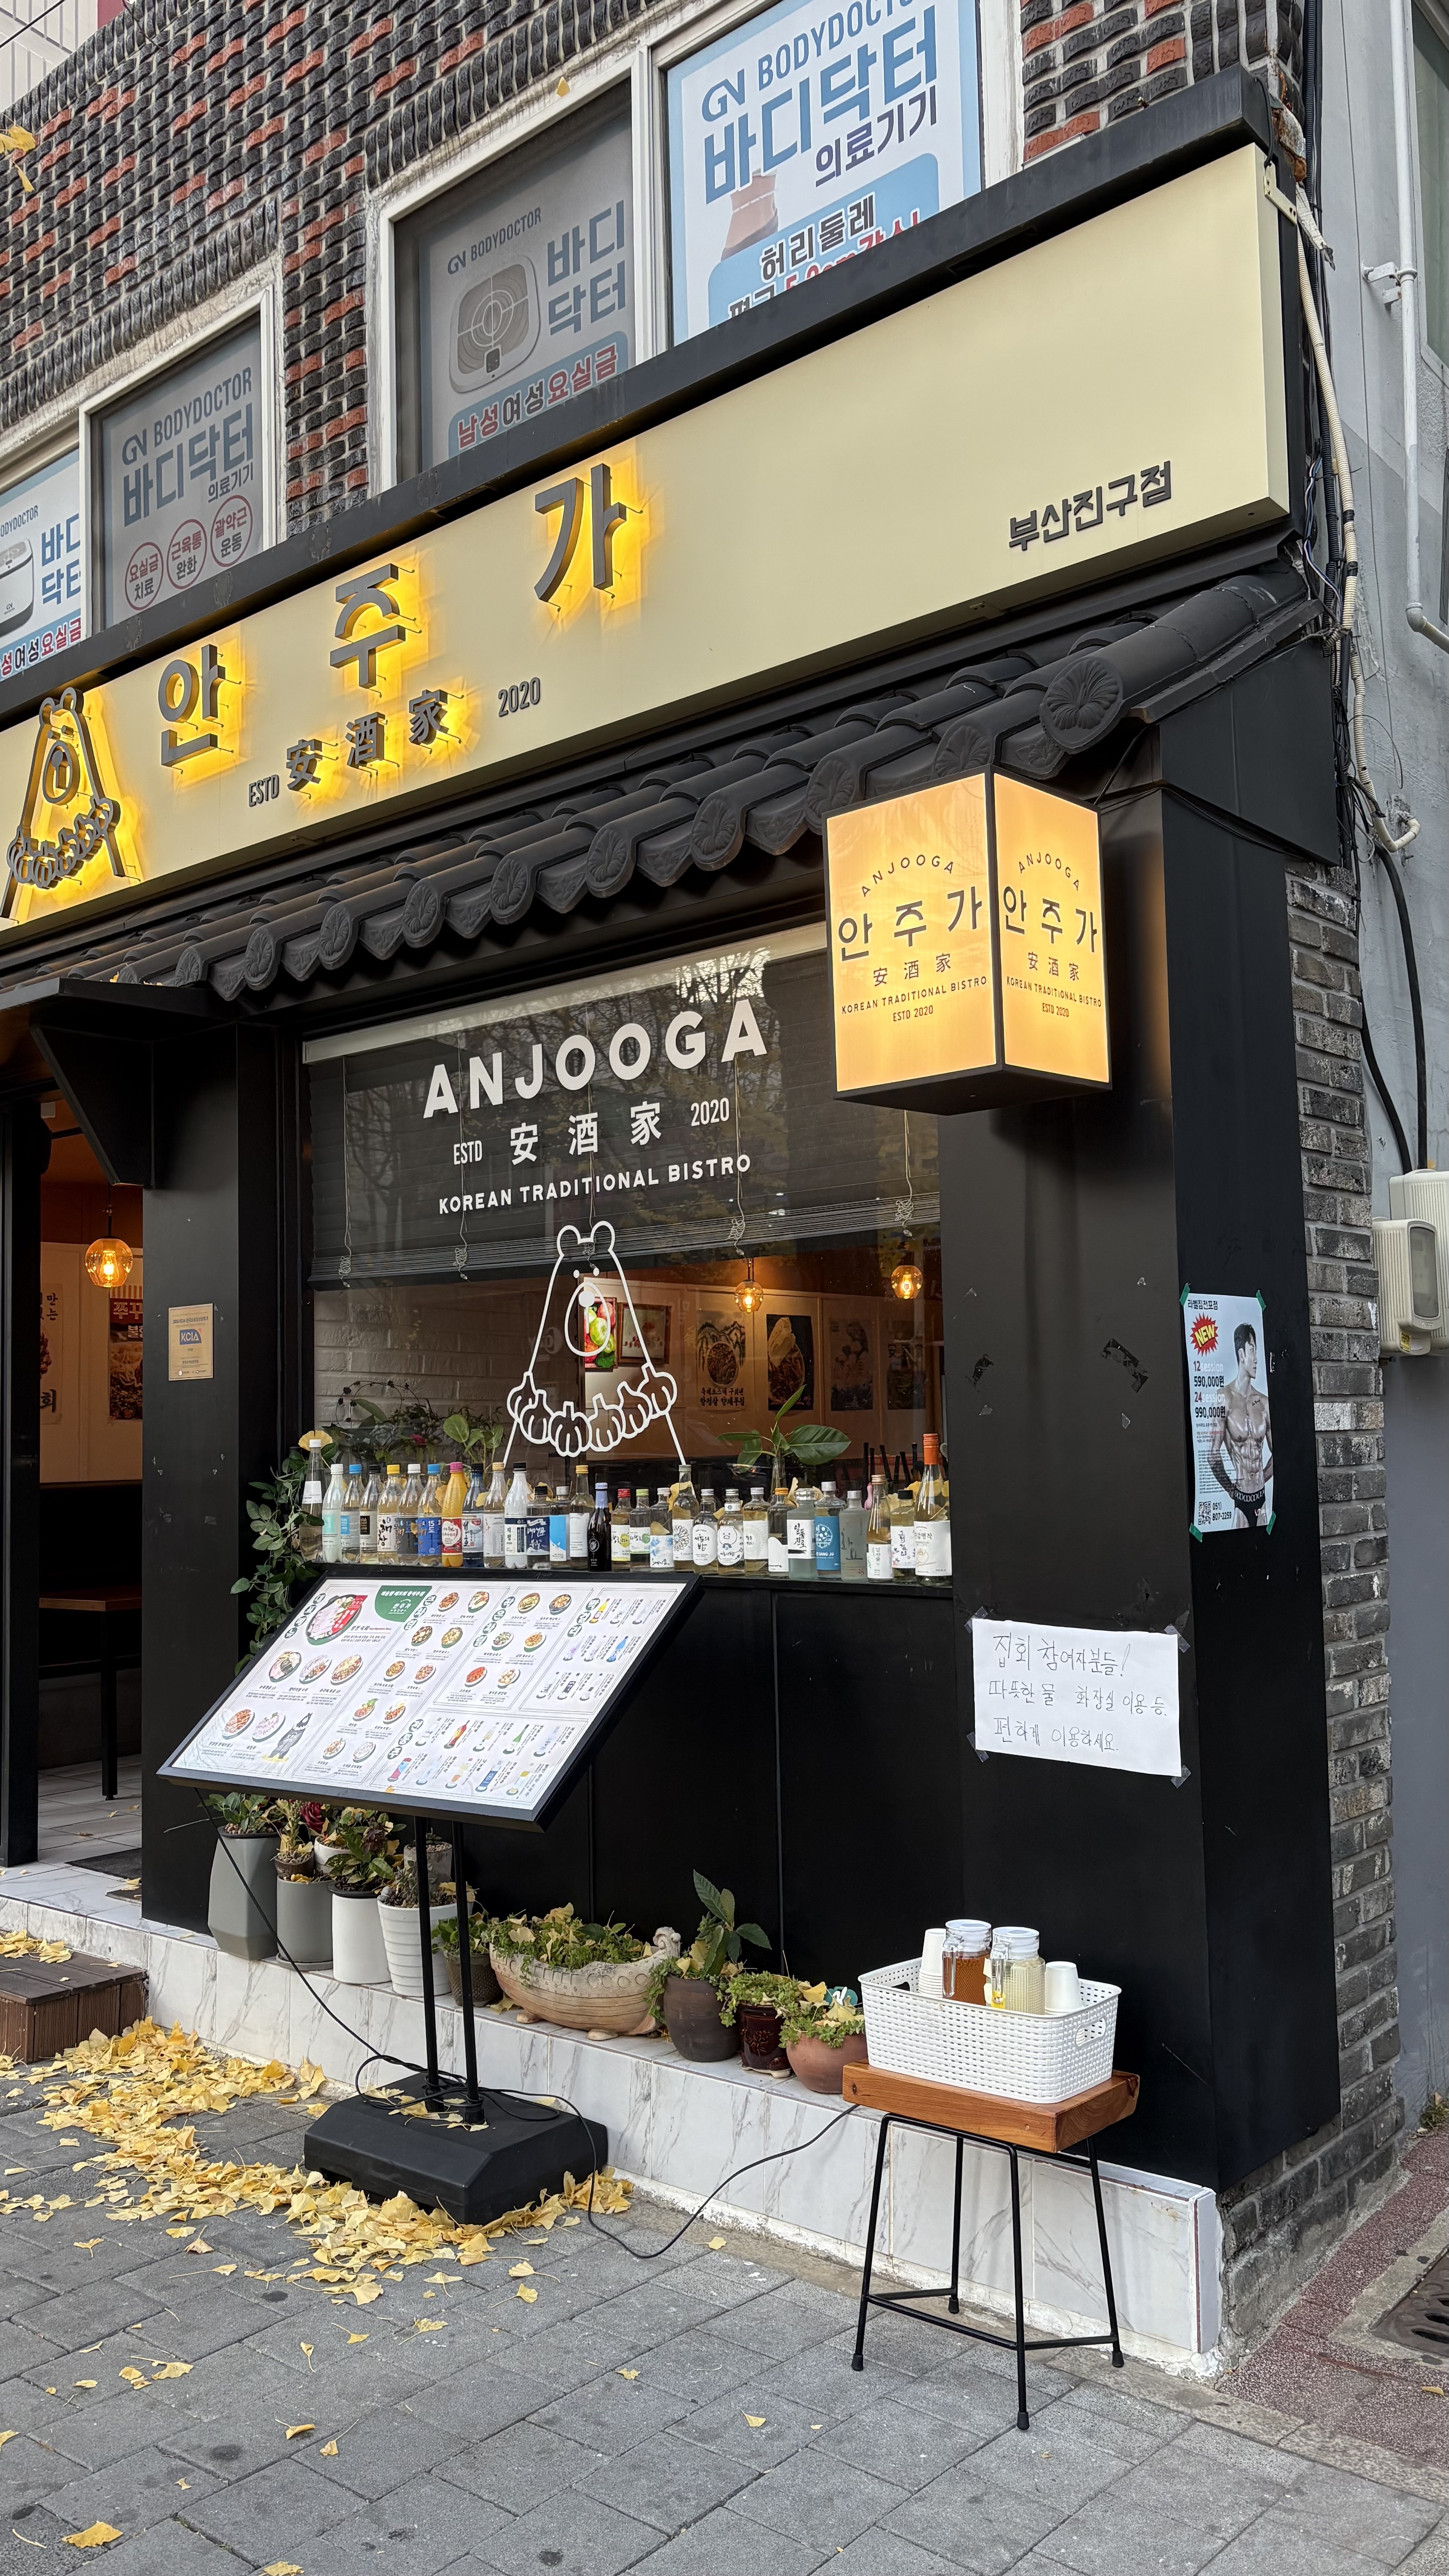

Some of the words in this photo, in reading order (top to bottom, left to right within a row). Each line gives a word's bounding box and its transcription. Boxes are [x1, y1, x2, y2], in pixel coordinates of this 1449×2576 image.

[758, 0, 913, 91] BODYDOC
[704, 5, 938, 204] 바디닥터
[815, 85, 937, 187] 의료기기
[470, 207, 541, 262] BODYDOCTOR
[547, 200, 625, 287] 바디
[548, 260, 626, 336] 닥터
[154, 367, 252, 447] BODYDOCTOR
[124, 403, 253, 527] 바디닥터
[207, 465, 254, 503] 의료기기
[215, 506, 247, 538] 괄약근
[1009, 460, 1171, 551] 부산진구점
[171, 530, 202, 561] 근육통
[221, 532, 242, 558] 운동
[129, 553, 159, 583] 요실금
[176, 555, 197, 580] 완화
[134, 577, 154, 602] 치료
[498, 677, 540, 718] 2020
[286, 689, 448, 791] 安酒家
[248, 774, 279, 807] ESTD
[861, 854, 954, 897] ANJOOGA
[1019, 852, 1079, 891] ANJOOGA
[839, 886, 982, 961] 안주가
[1003, 886, 1097, 953] 안주가
[873, 953, 951, 987] 安酒家
[1028, 952, 1079, 981] 安酒家
[842, 999, 878, 1014] KOREAN
[881, 984, 947, 1007] TRADITIONAL
[951, 976, 987, 992] BISTRO
[1007, 976, 1032, 992] KOREAN
[1034, 983, 1077, 1003] TRADITIONAL
[1079, 995, 1102, 1007] BISTRO
[1042, 1003, 1054, 1014] ESTD
[1056, 1006, 1069, 1017] 2020
[893, 1010, 911, 1022] ESTD
[914, 1005, 934, 1018] 2020
[423, 999, 767, 1118] ANJOOGA
[691, 1098, 729, 1127] 2020
[510, 1101, 662, 1165] 安酒家
[454, 1141, 483, 1165] ESTD
[439, 1189, 512, 1214] KOREAN
[520, 1168, 659, 1202] TRADITIONAL
[668, 1155, 750, 1182] BISTRO
[181, 1332, 199, 1342] KCIA
[1195, 1324, 1214, 1348] NEW
[1194, 1375, 1224, 1388] 590,000원
[1195, 1406, 1225, 1419] 990,000원
[993, 1632, 1030, 1671] 집회
[989, 1679, 1035, 1704] 따뜻한
[1042, 1684, 1055, 1706] 물
[1075, 1686, 1115, 1711] 화장실
[1123, 1691, 1147, 1714] 이용
[994, 1716, 1040, 1747] 편하게
